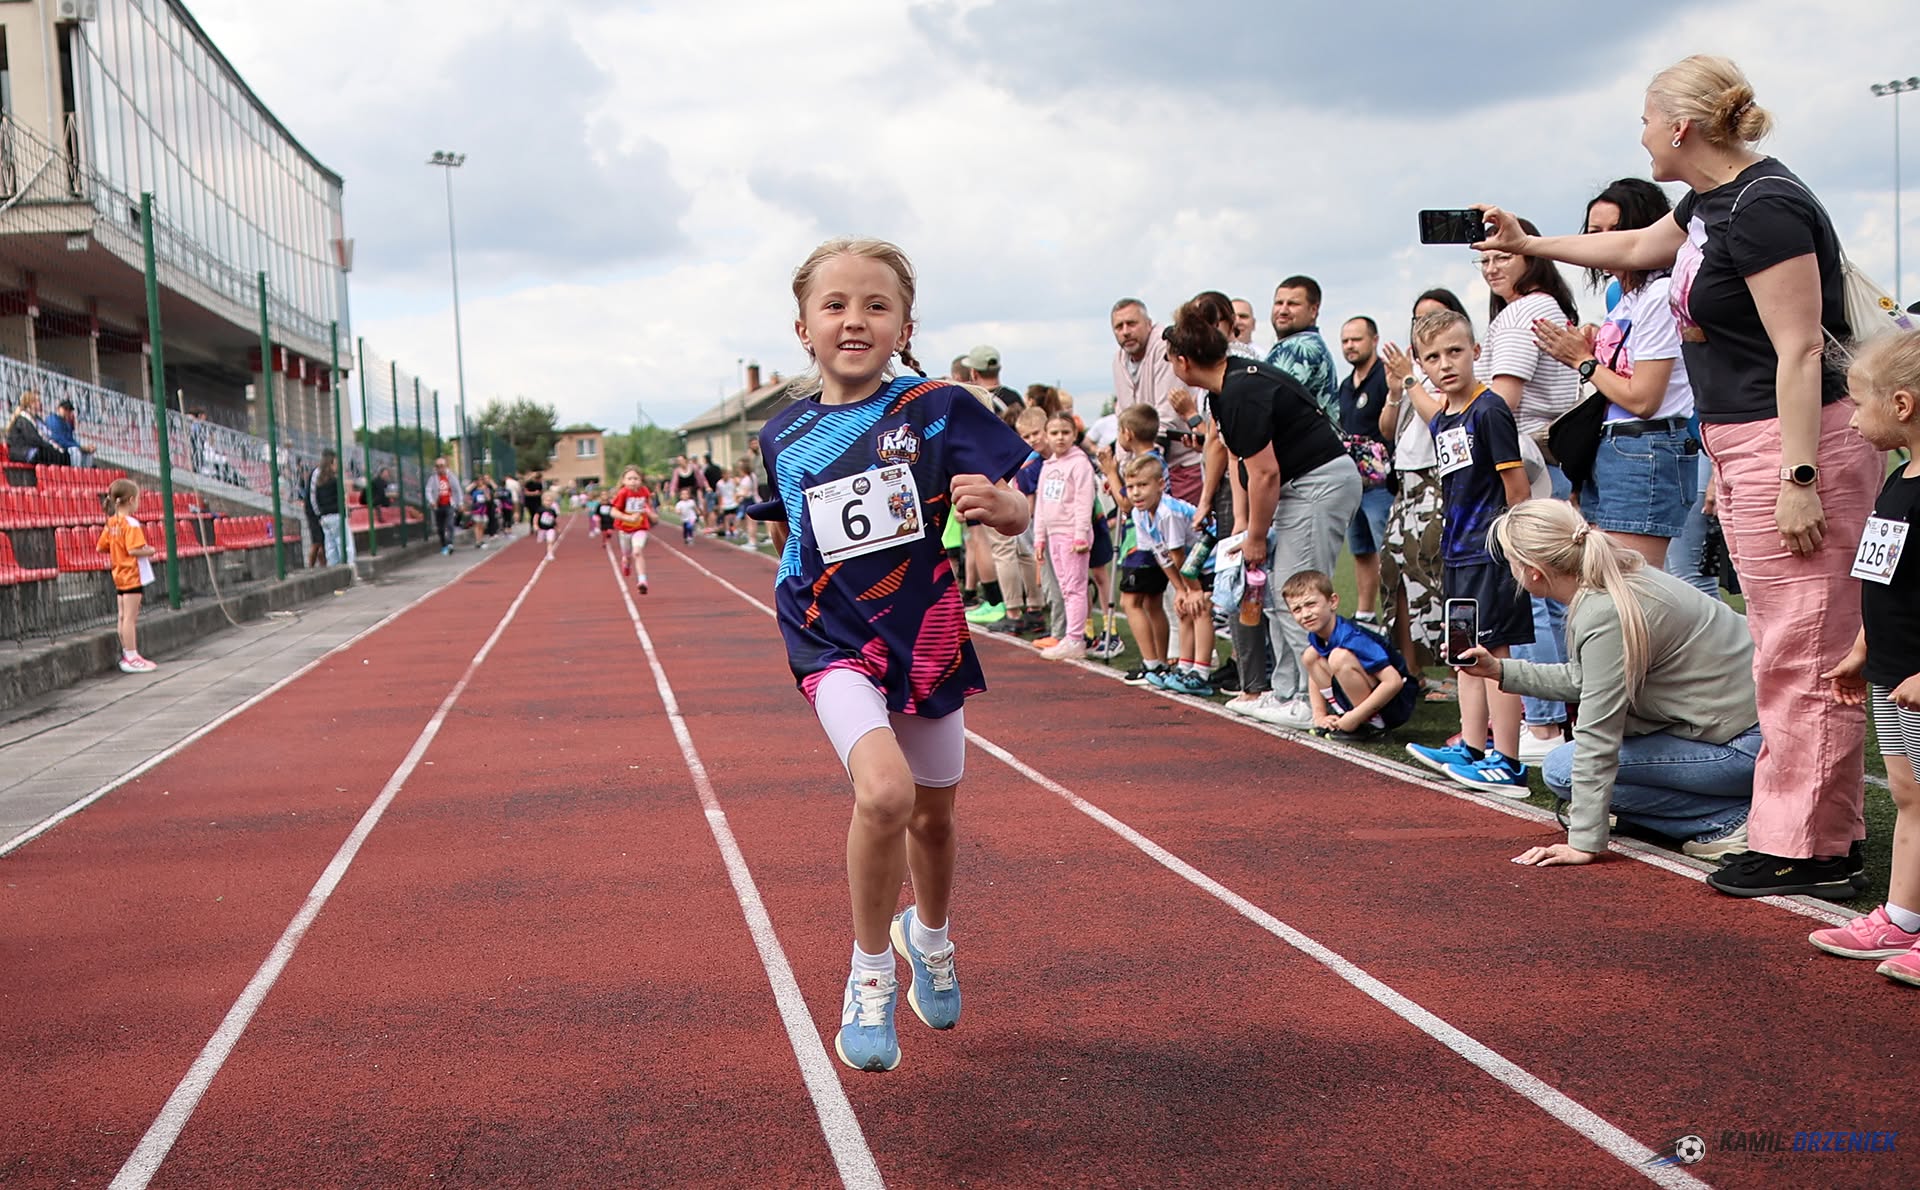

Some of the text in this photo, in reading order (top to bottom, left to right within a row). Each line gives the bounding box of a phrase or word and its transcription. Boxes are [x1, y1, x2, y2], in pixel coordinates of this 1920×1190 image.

[883, 436, 917, 453] AMB
[842, 499, 871, 541] 6
[1858, 541, 1886, 567] 126
